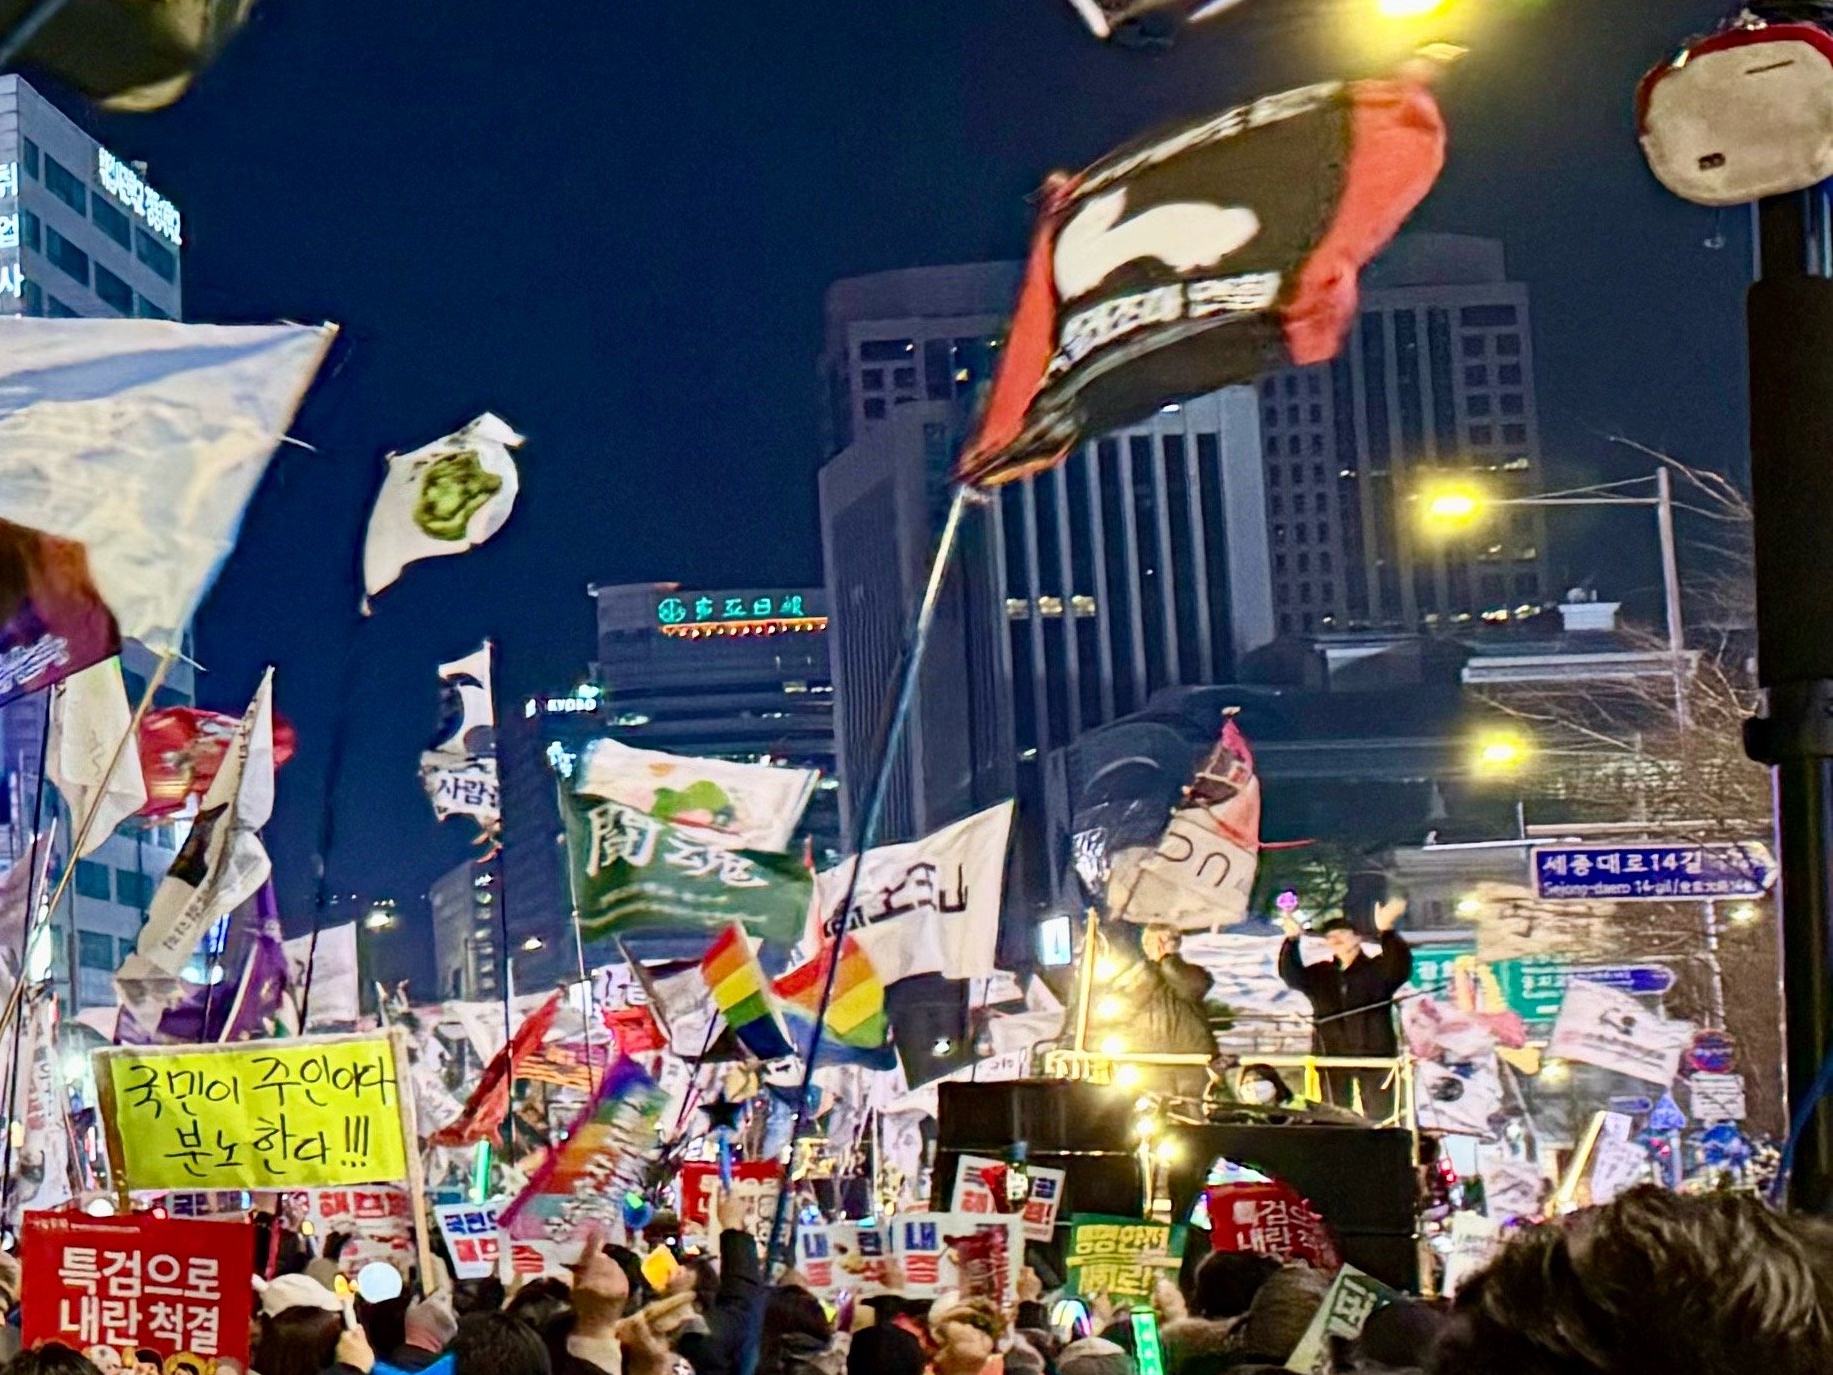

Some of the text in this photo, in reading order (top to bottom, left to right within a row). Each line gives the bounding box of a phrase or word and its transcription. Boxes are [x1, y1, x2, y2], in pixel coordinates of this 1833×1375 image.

[1542, 851, 1703, 876] 세종대로14길
[124, 1064, 240, 1119] 국민이
[164, 1113, 332, 1178] 분노한다
[58, 1245, 221, 1302] 특검으로
[60, 1295, 220, 1355] 내란 척결
